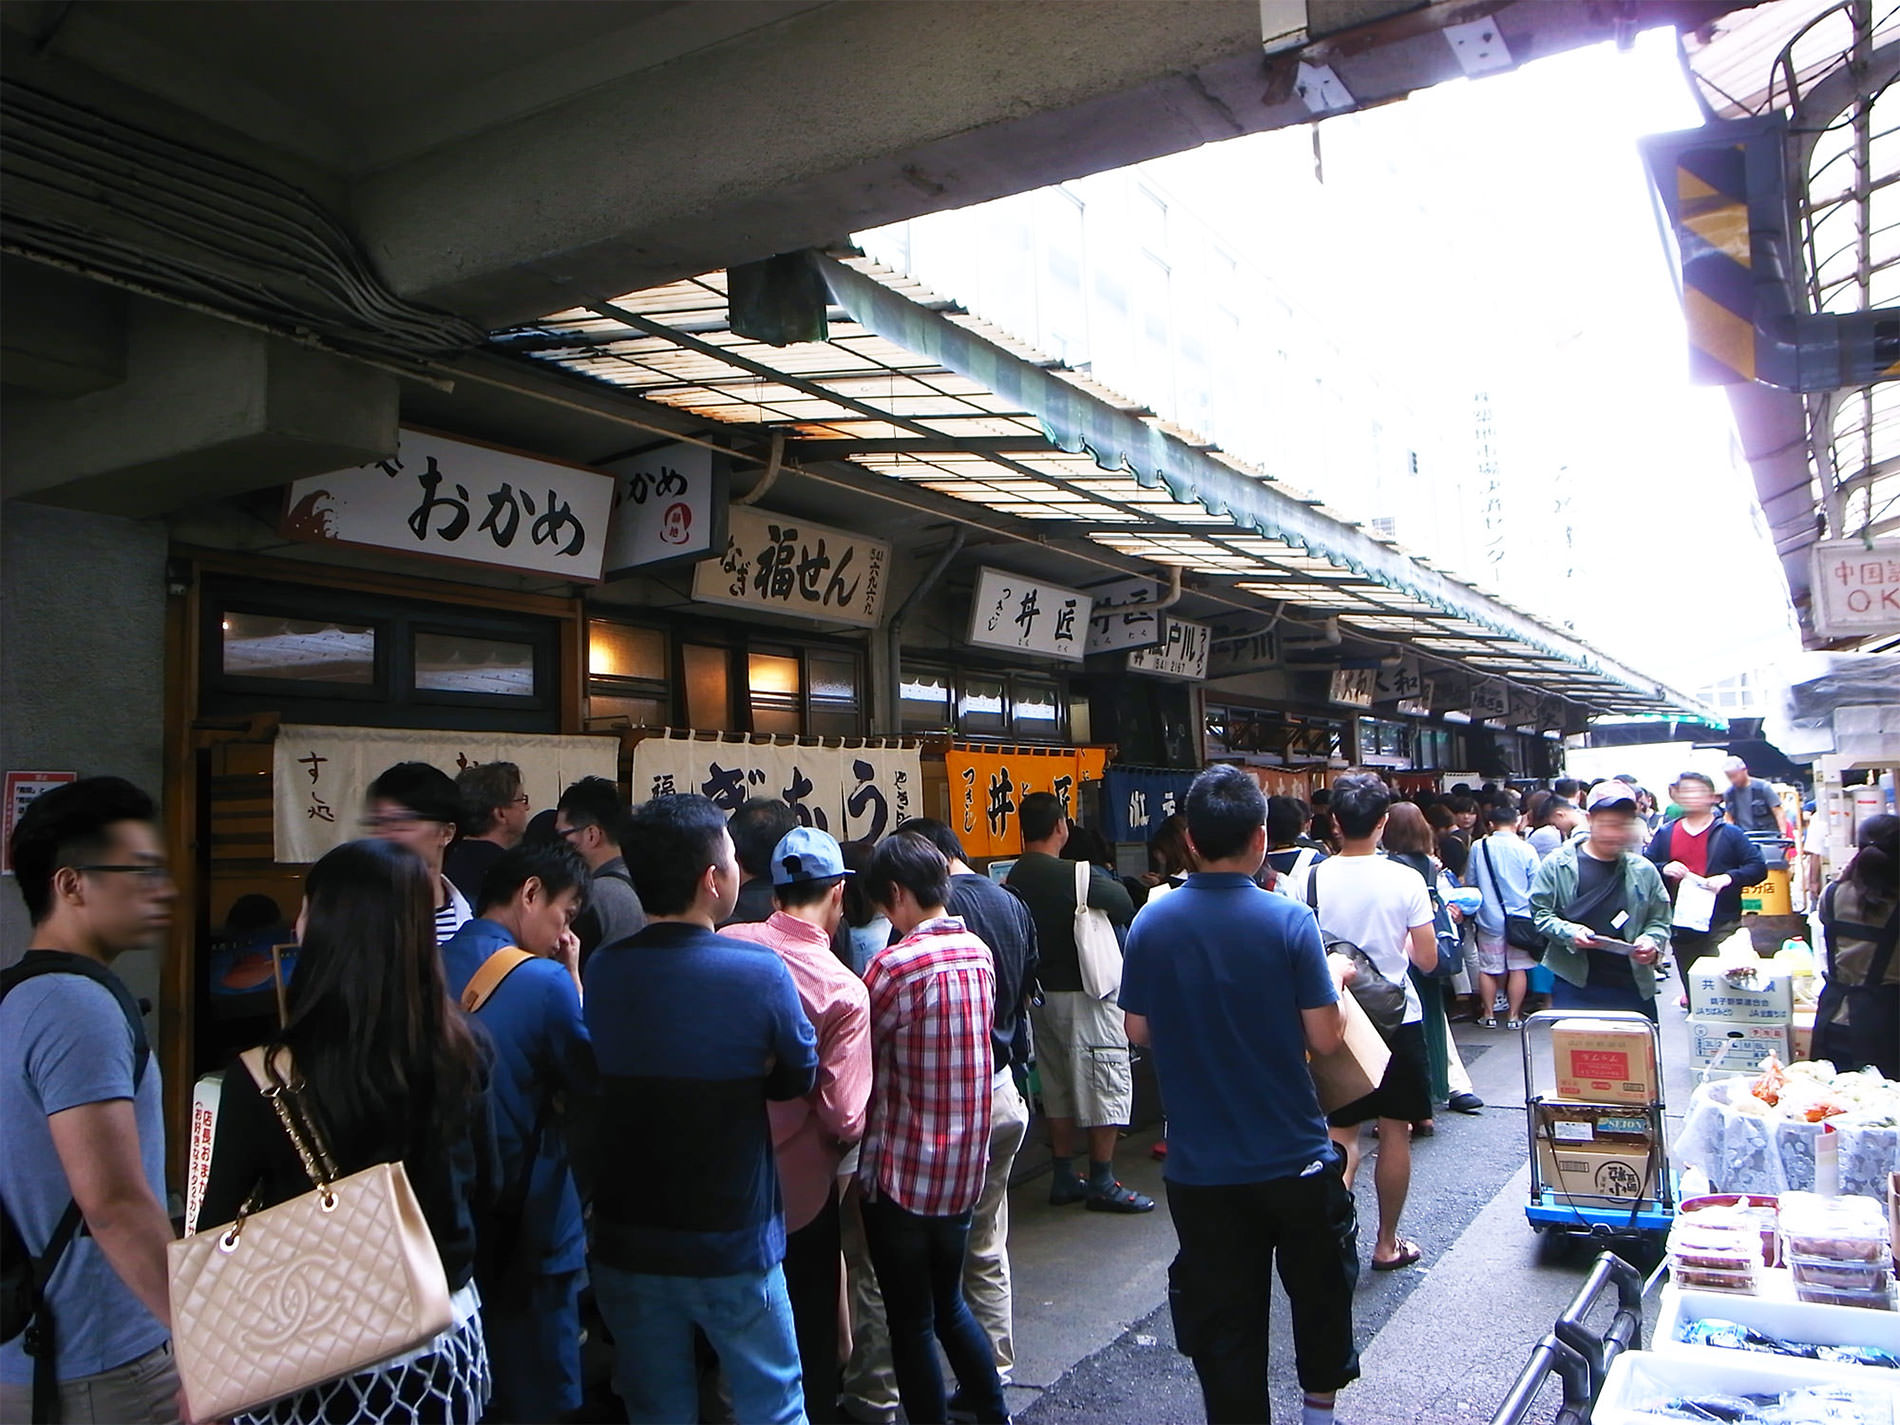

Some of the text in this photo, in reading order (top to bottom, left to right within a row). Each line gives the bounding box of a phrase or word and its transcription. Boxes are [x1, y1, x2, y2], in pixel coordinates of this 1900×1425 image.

[407, 455, 586, 557] おかめ
[614, 466, 688, 508] かめ
[754, 525, 861, 608] 福せん
[987, 588, 1012, 632] つきじ
[1847, 587, 1900, 613] OK
[297, 751, 336, 823] すし処
[962, 767, 977, 833] つきじ
